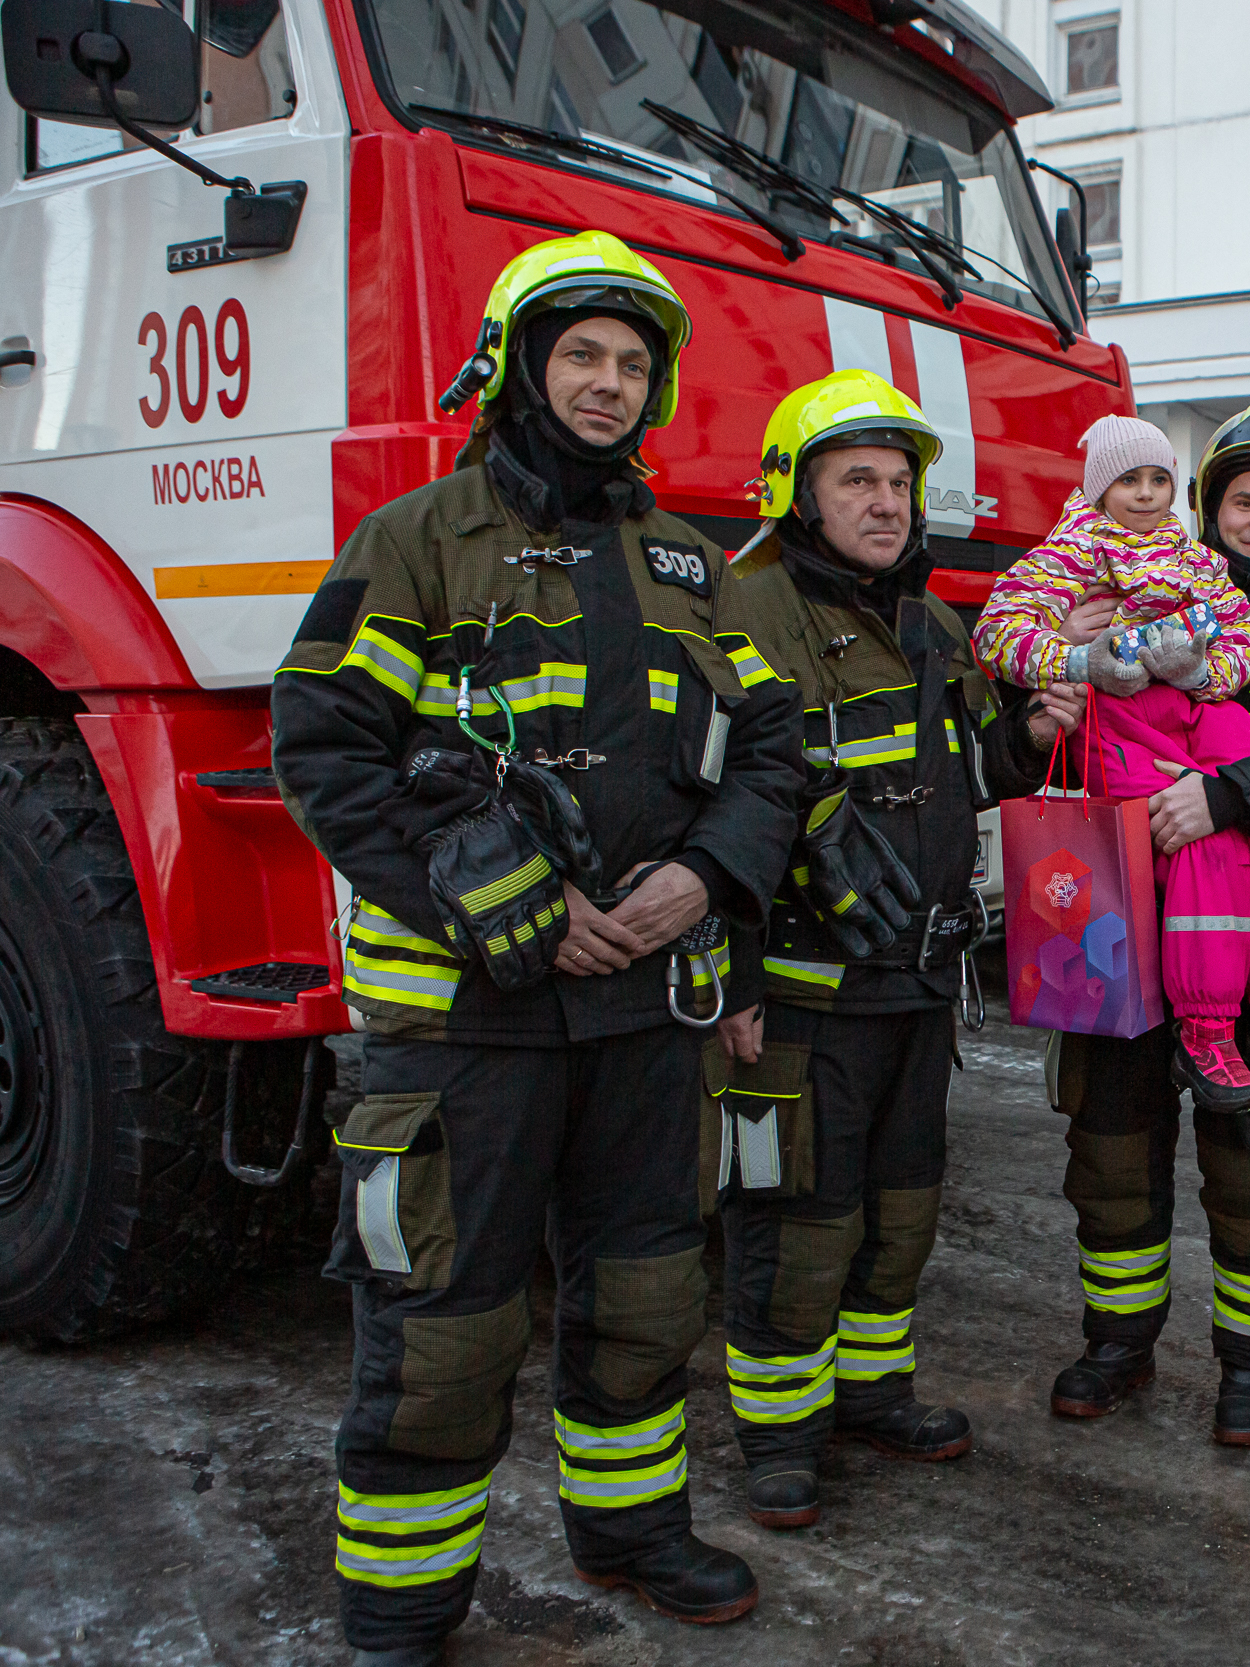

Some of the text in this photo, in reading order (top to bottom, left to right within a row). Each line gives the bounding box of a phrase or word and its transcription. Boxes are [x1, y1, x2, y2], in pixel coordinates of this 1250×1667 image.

[171, 243, 235, 266] 4311
[138, 297, 251, 429] 309
[152, 455, 266, 506] МОСКВА
[648, 546, 705, 585] 309
